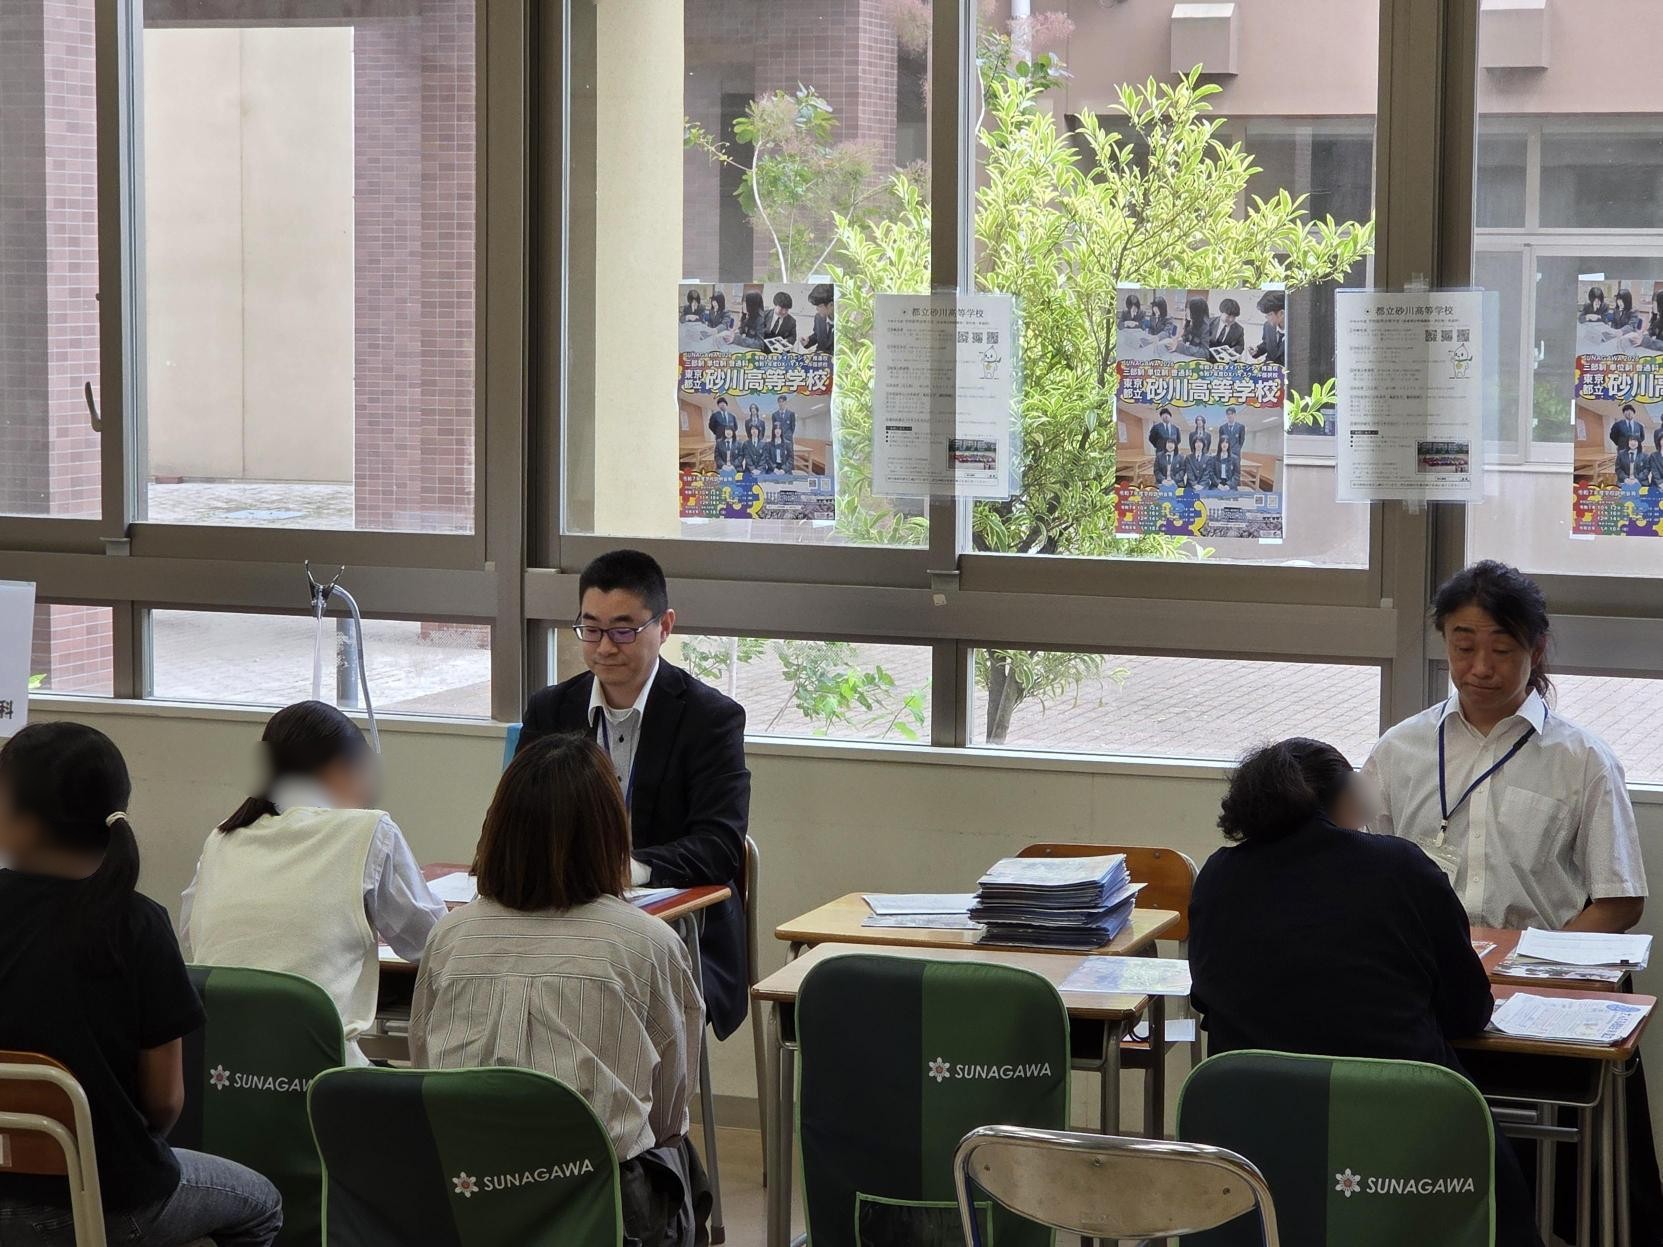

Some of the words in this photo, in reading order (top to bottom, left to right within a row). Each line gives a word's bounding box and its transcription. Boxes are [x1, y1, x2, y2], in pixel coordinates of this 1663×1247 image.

[706, 369, 828, 390] 砂川高等学校
[1146, 378, 1278, 402] 砂川高等学校
[954, 1062, 1051, 1079] SUNAGAWA
[233, 1072, 312, 1092] SUNAGAW
[483, 1158, 594, 1191] SUNAGAWA
[1366, 1177, 1475, 1194] SUNAGAWA
